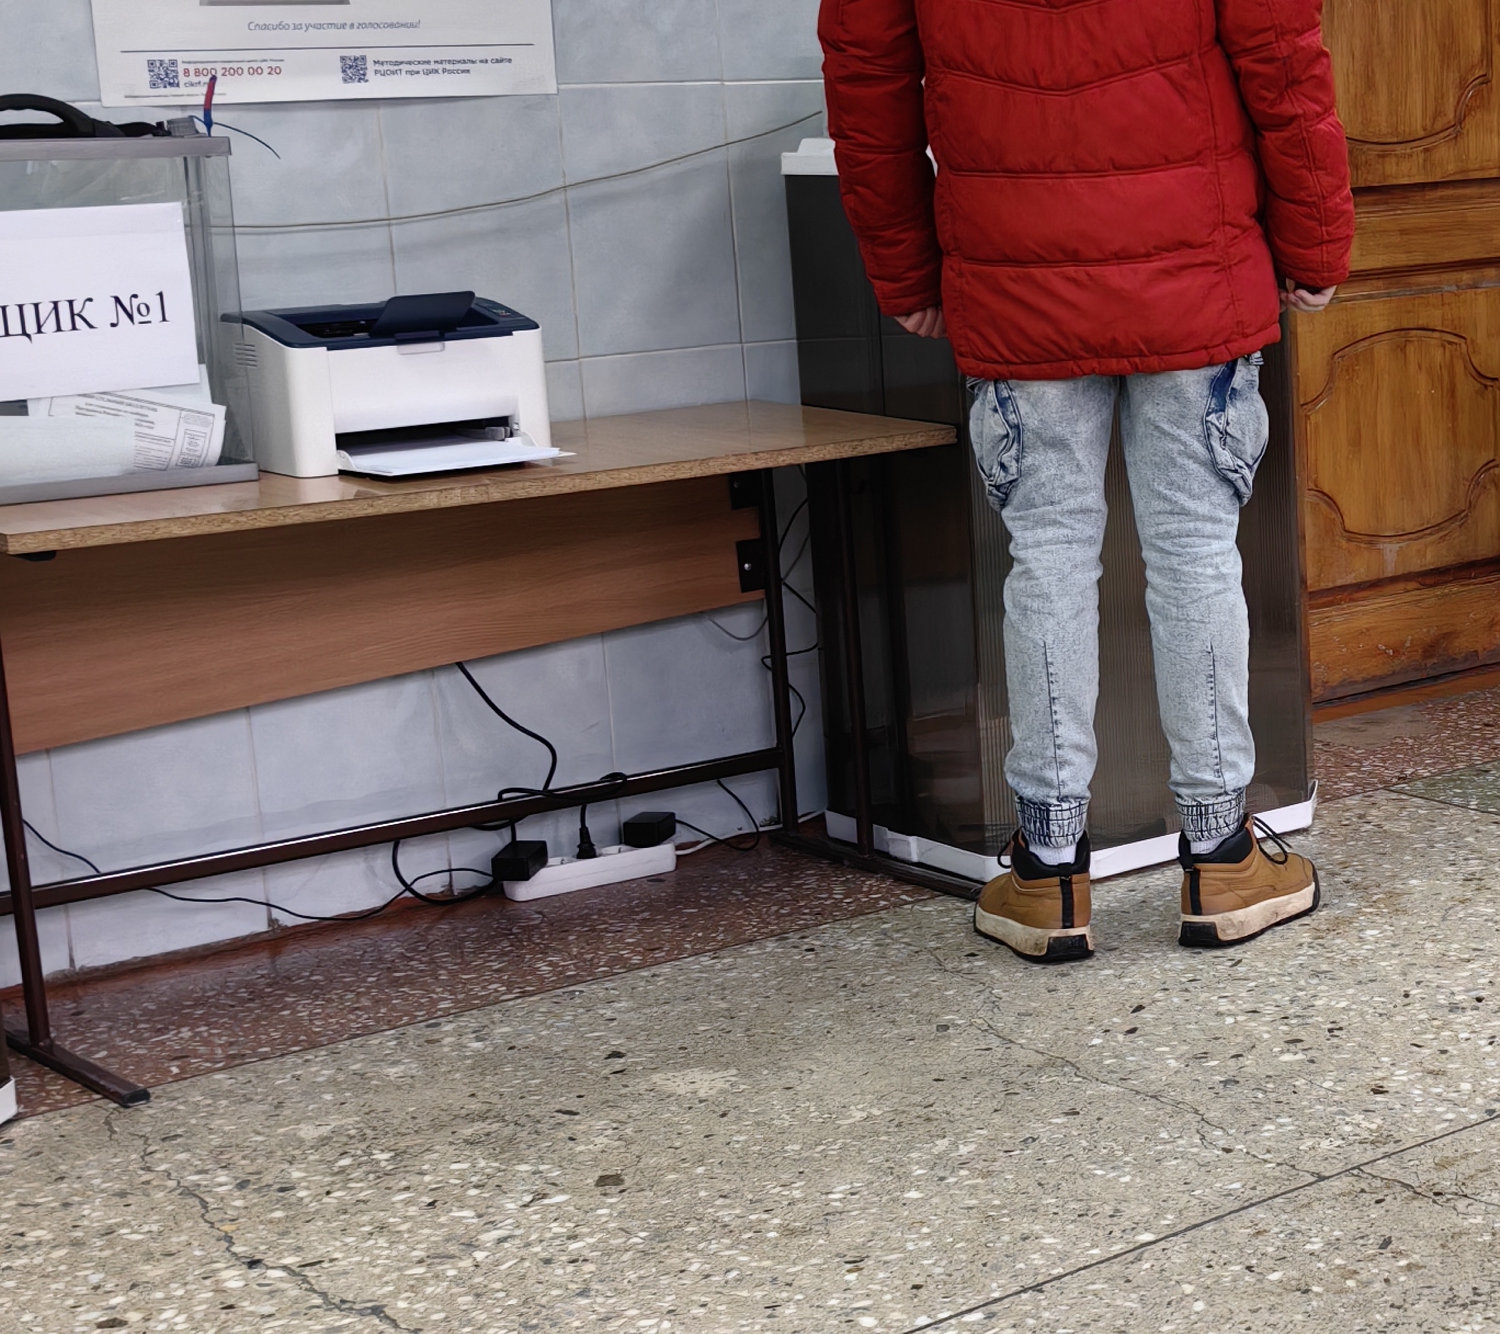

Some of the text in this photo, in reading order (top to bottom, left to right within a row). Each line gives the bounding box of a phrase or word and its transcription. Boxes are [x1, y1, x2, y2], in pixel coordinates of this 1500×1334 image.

[247, 20, 290, 31] Спасибо
[304, 22, 347, 33] участие
[183, 65, 283, 77] 8 800 200 00 20
[109, 290, 170, 328] №1
